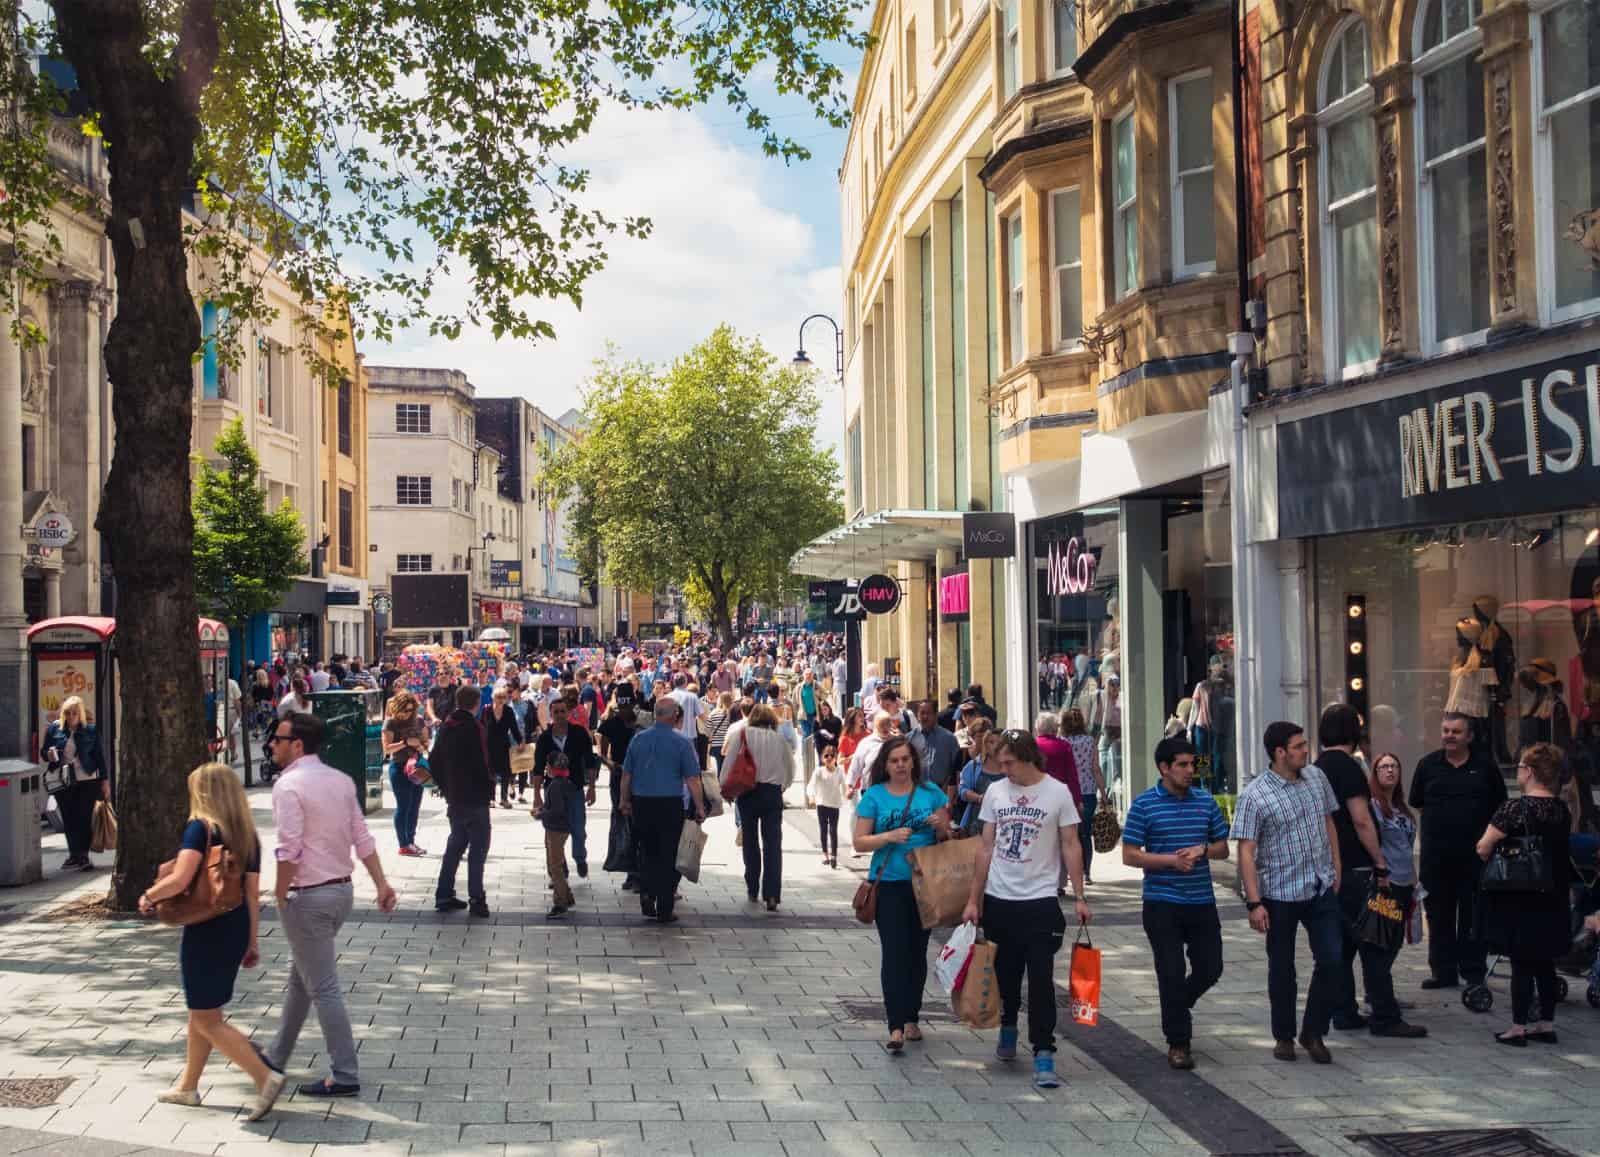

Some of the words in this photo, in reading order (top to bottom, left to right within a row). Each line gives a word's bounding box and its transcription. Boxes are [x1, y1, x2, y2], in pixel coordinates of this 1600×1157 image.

[1399, 391, 1504, 499] RIVER
[39, 529, 68, 539] HSBC
[969, 528, 1005, 543] M&Co
[1047, 536, 1091, 596] M&Co
[862, 588, 896, 601] HMV
[833, 593, 861, 615] JD
[998, 806, 1048, 820] SUPERDRY
